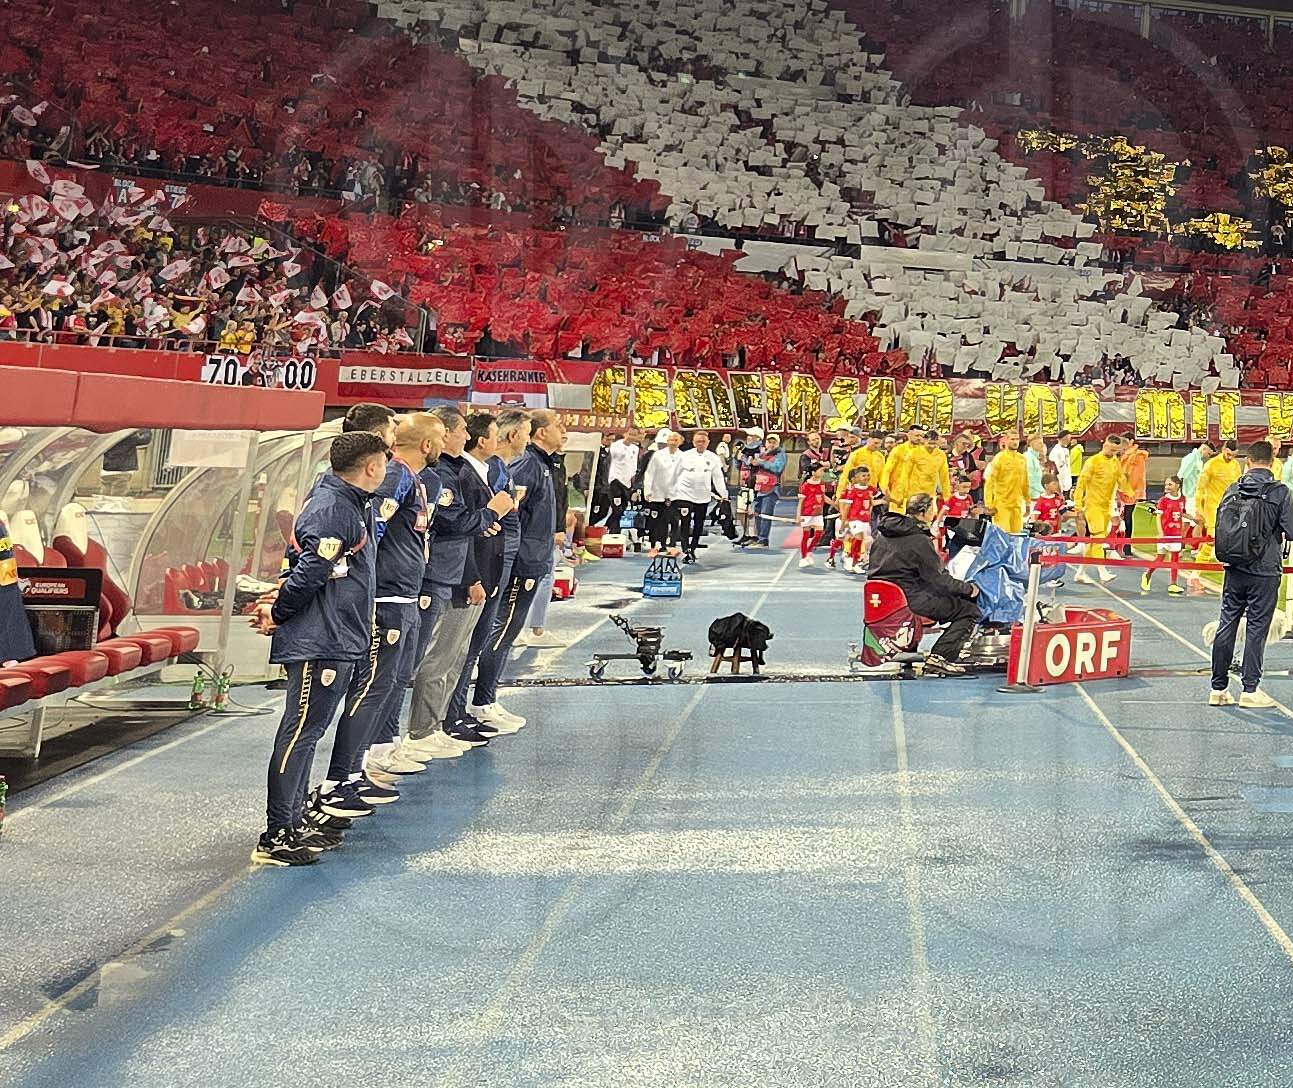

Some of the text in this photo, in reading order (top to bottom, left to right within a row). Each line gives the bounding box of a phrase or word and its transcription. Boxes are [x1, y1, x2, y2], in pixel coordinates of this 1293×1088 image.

[350, 368, 461, 385] EBERSTALZELL
[591, 365, 953, 435] GEMEINSAM
[985, 382, 1100, 438] UND
[1135, 387, 1240, 440] MIT
[1045, 630, 1121, 677] ORF
